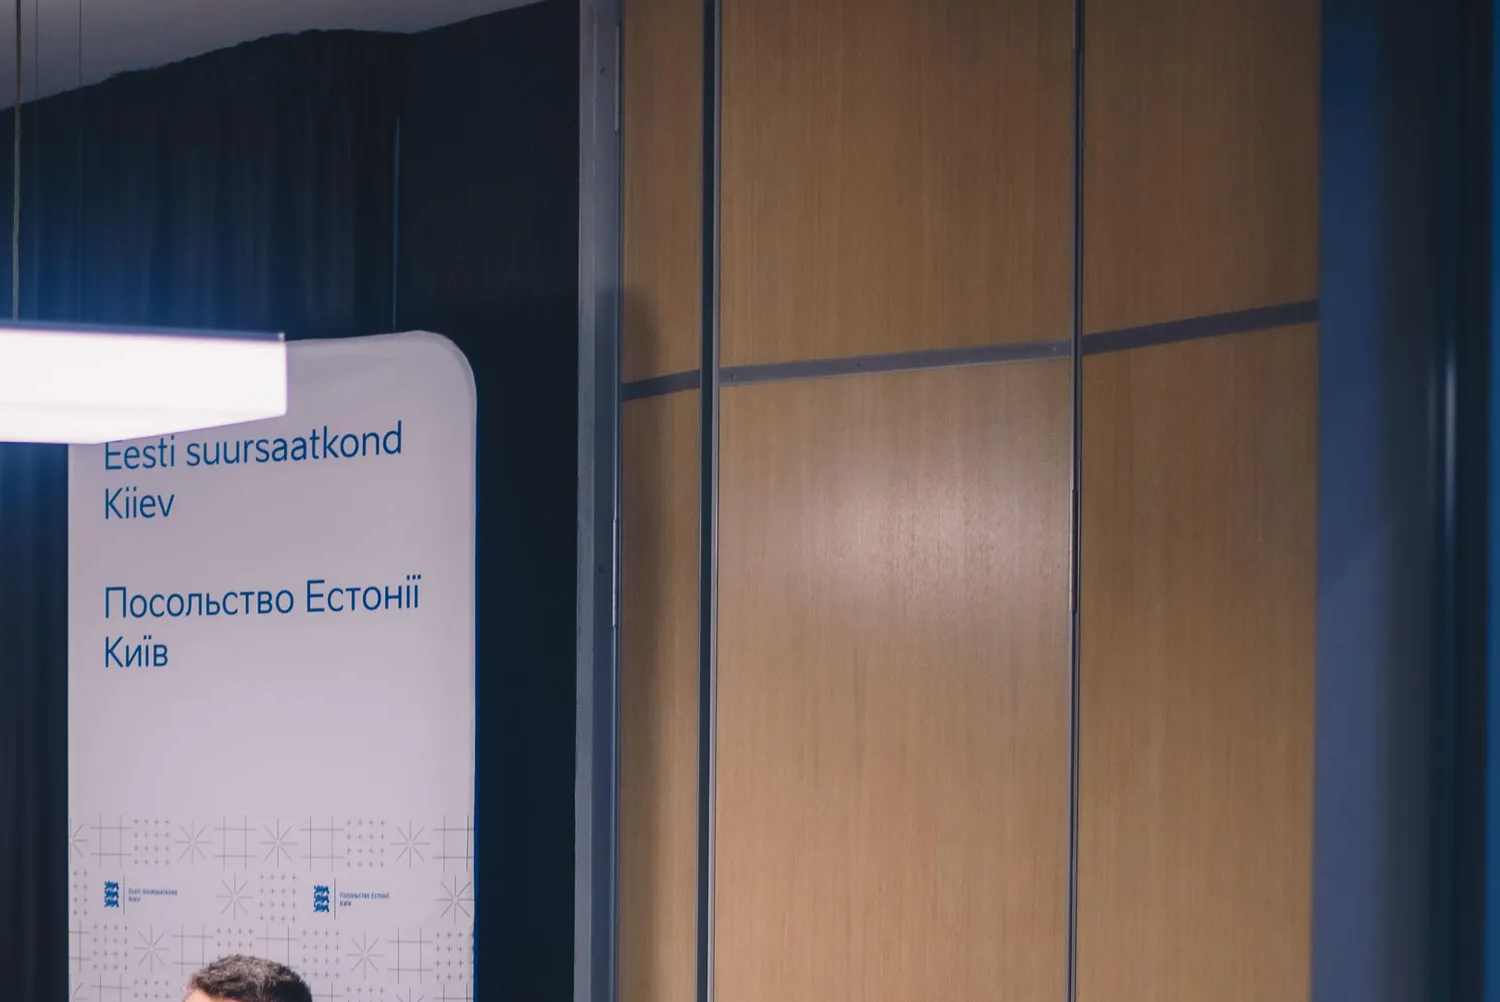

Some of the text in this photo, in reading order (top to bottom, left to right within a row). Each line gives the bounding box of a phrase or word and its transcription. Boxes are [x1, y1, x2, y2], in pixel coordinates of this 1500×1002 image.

[105, 420, 403, 470] Eesti suursaatkond
[105, 486, 175, 520] Kiiev
[105, 574, 422, 619] Посольство Естонії
[105, 634, 169, 669] Київ
